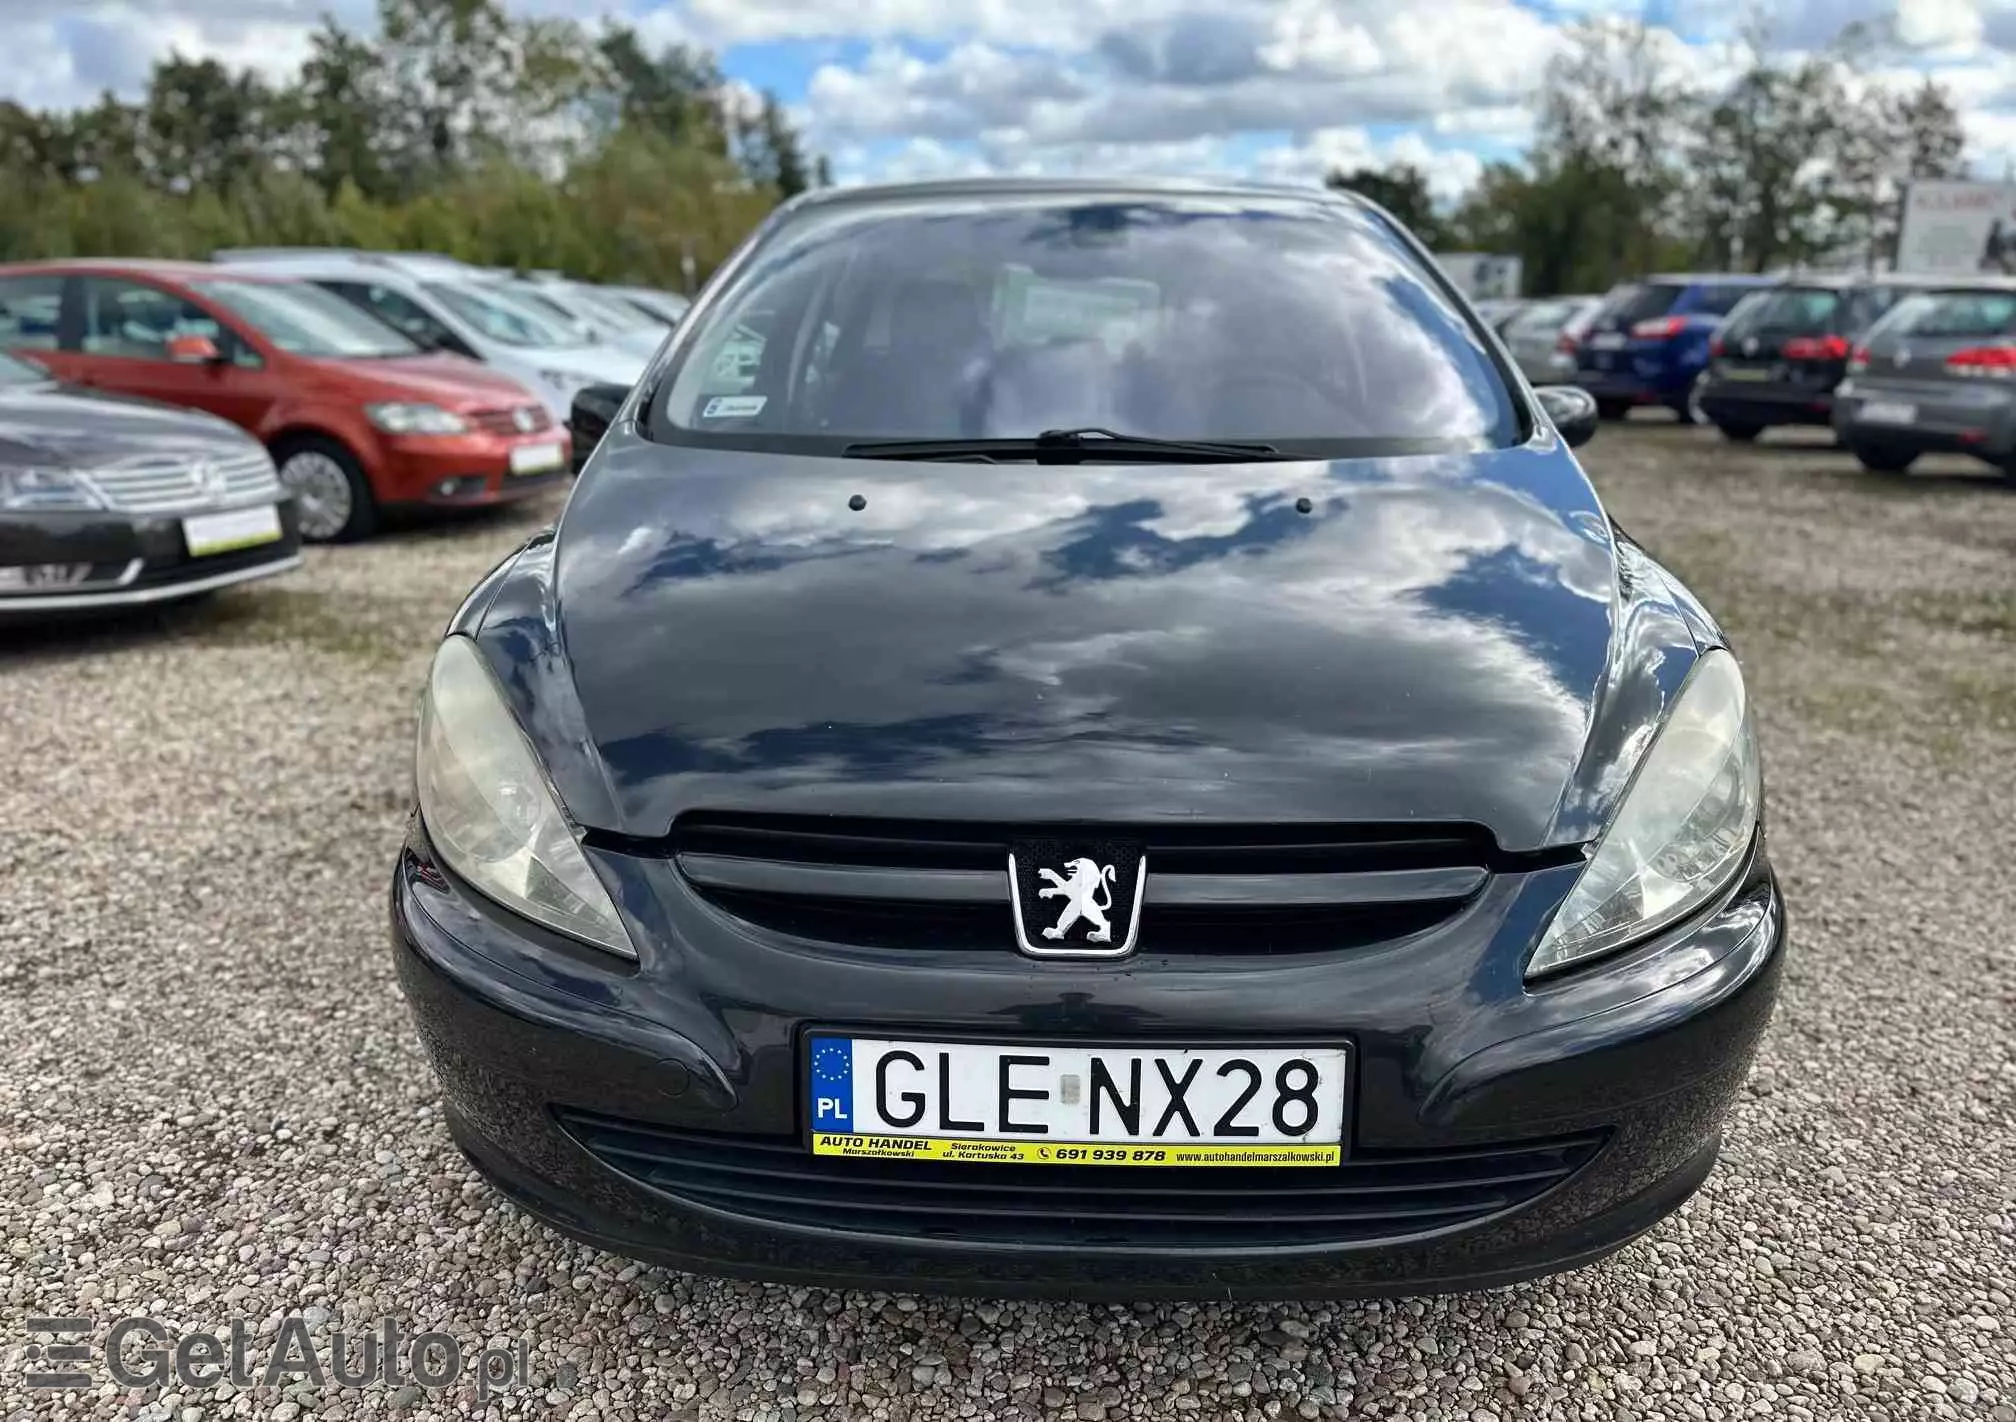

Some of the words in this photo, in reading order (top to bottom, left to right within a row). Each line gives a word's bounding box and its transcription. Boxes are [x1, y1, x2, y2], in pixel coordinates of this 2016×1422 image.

[818, 1097, 848, 1119] PL
[876, 1050, 1050, 1134] GLE
[1090, 1057, 1319, 1137] NX28
[820, 1136, 864, 1147] AUTO
[868, 1139, 932, 1151] HANDEL
[951, 1142, 1016, 1152] Sierakowice
[942, 1150, 955, 1158] ul.
[958, 1151, 1007, 1160] Kartuska
[1010, 1152, 1025, 1160] 43
[1056, 1149, 1088, 1160] 691
[1092, 1150, 1127, 1161] 939
[1132, 1151, 1166, 1162] 878
[1176, 1151, 1335, 1163] www.autohandelmarszalkowski.pl
